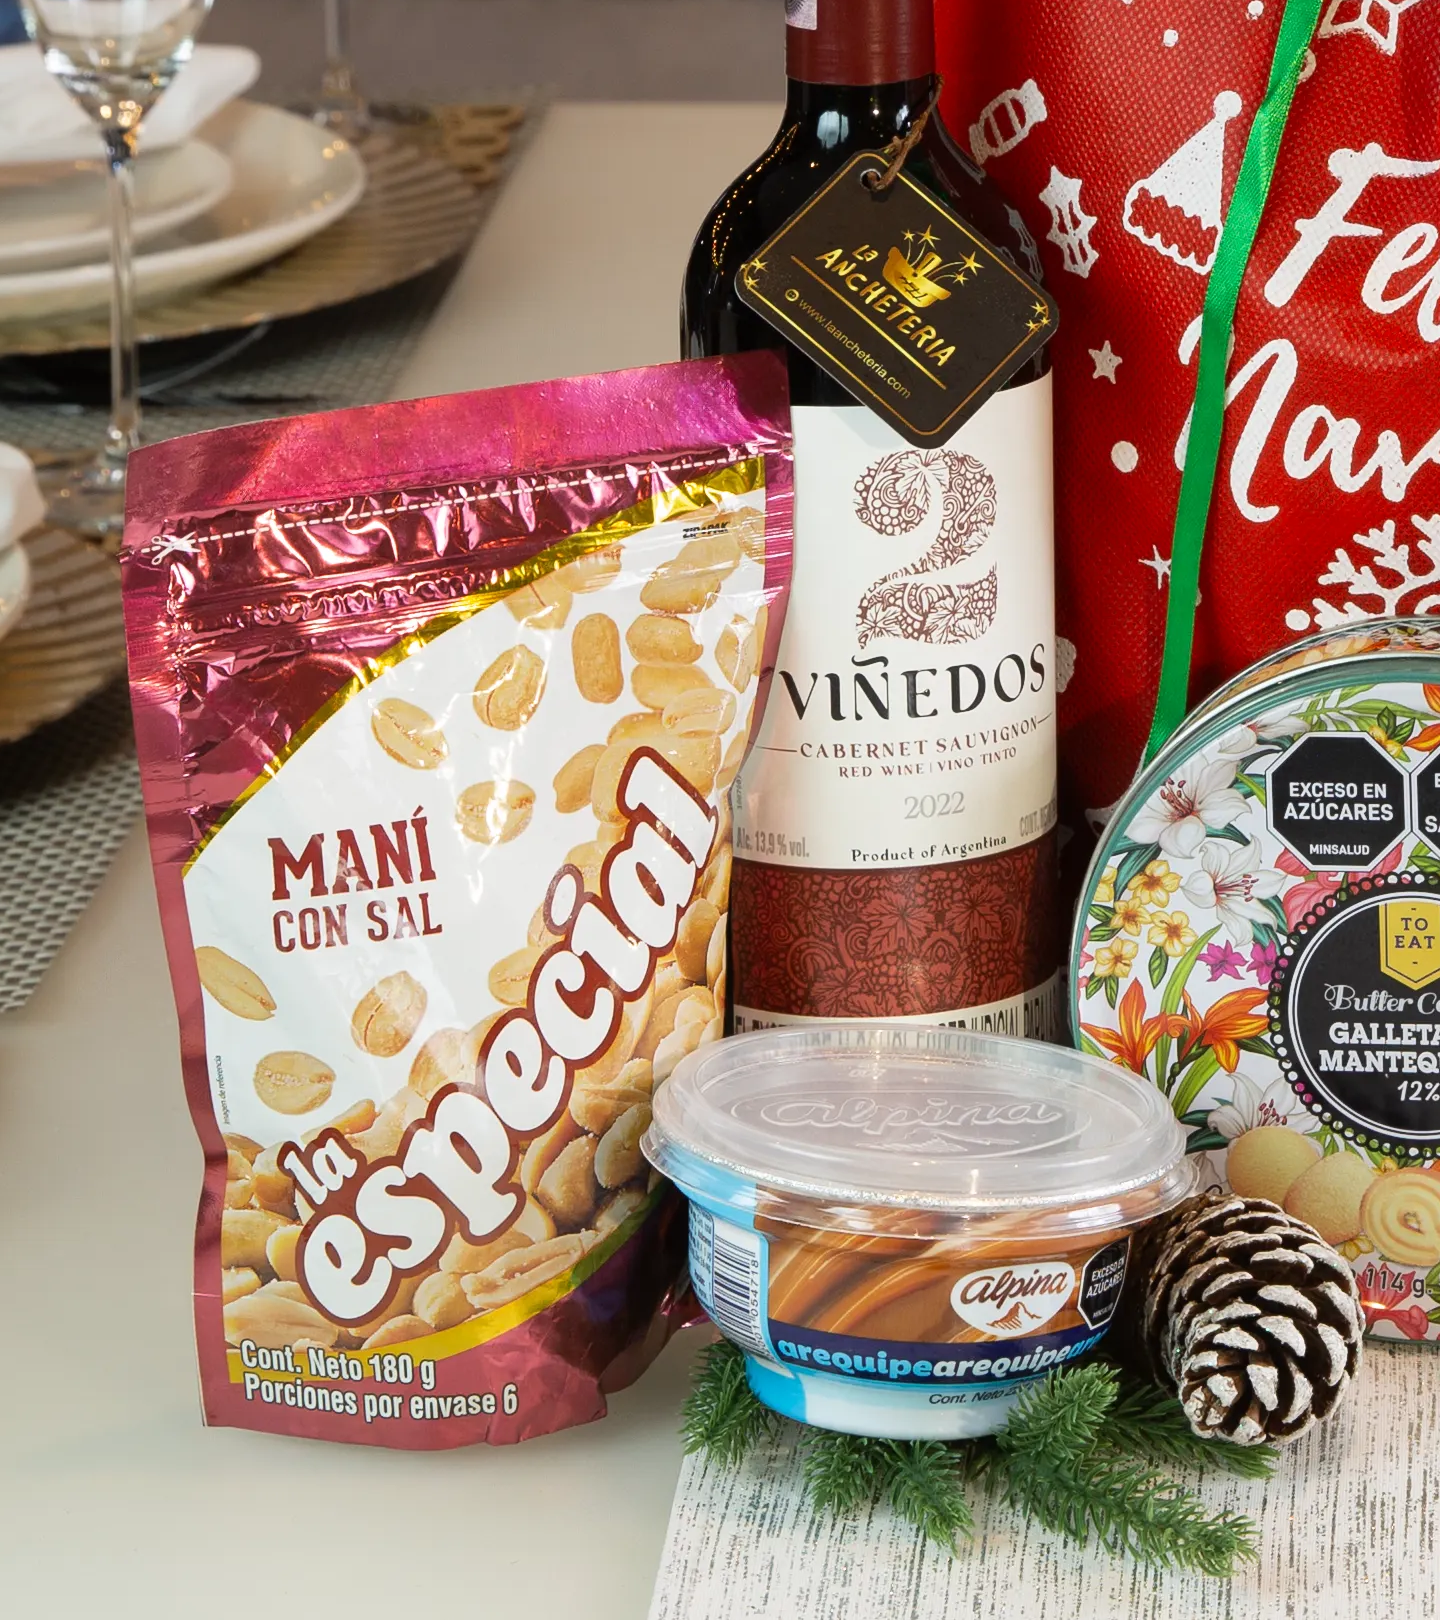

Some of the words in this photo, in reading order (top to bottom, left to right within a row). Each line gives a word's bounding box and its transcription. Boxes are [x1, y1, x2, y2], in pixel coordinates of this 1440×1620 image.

[815, 248, 956, 367] ANCHETERIA
[798, 298, 911, 399] www.laancheteria.com
[778, 643, 1045, 721] VIÑEDOS
[800, 739, 928, 759] CABERNET
[936, 715, 1038, 754] SAUVIGNON
[839, 765, 872, 778] RED
[881, 762, 924, 776] WINE
[937, 756, 974, 772] VINO
[979, 746, 1017, 765] TINTO
[904, 791, 965, 819] 2022
[1289, 782, 1357, 799] EXCESO
[1363, 783, 1387, 799] EN
[1284, 798, 1393, 821] AZÚCARES
[267, 805, 437, 901] MANÍ
[736, 827, 752, 851] Alc.
[789, 837, 810, 858] vol.
[851, 847, 914, 862] Product
[921, 845, 937, 858] of
[941, 836, 1007, 857] Argentina
[1309, 844, 1370, 856] MINSALUD
[273, 904, 349, 953] CON
[366, 892, 443, 942] SAL
[1401, 917, 1428, 931] TO
[1394, 935, 1435, 949] EAT
[1324, 983, 1413, 1012] Butter
[298, 749, 717, 1325] especial
[1397, 1081, 1440, 1102] 12%
[284, 1132, 358, 1204] la
[1086, 1270, 1123, 1298] AZÚCARES
[1092, 1262, 1117, 1282] EXCESO
[1367, 1267, 1403, 1292] 114
[1412, 1278, 1432, 1298] g.
[240, 1338, 302, 1374] Cont.
[307, 1347, 362, 1381] Neto
[368, 1353, 413, 1384] 180
[420, 1359, 436, 1390] g
[243, 1372, 358, 1415] Porciones
[364, 1392, 404, 1423] por
[410, 1392, 496, 1420] envase
[502, 1383, 518, 1414] 6
[929, 1393, 967, 1404] Cont.
[971, 1390, 1004, 1402] Neto
